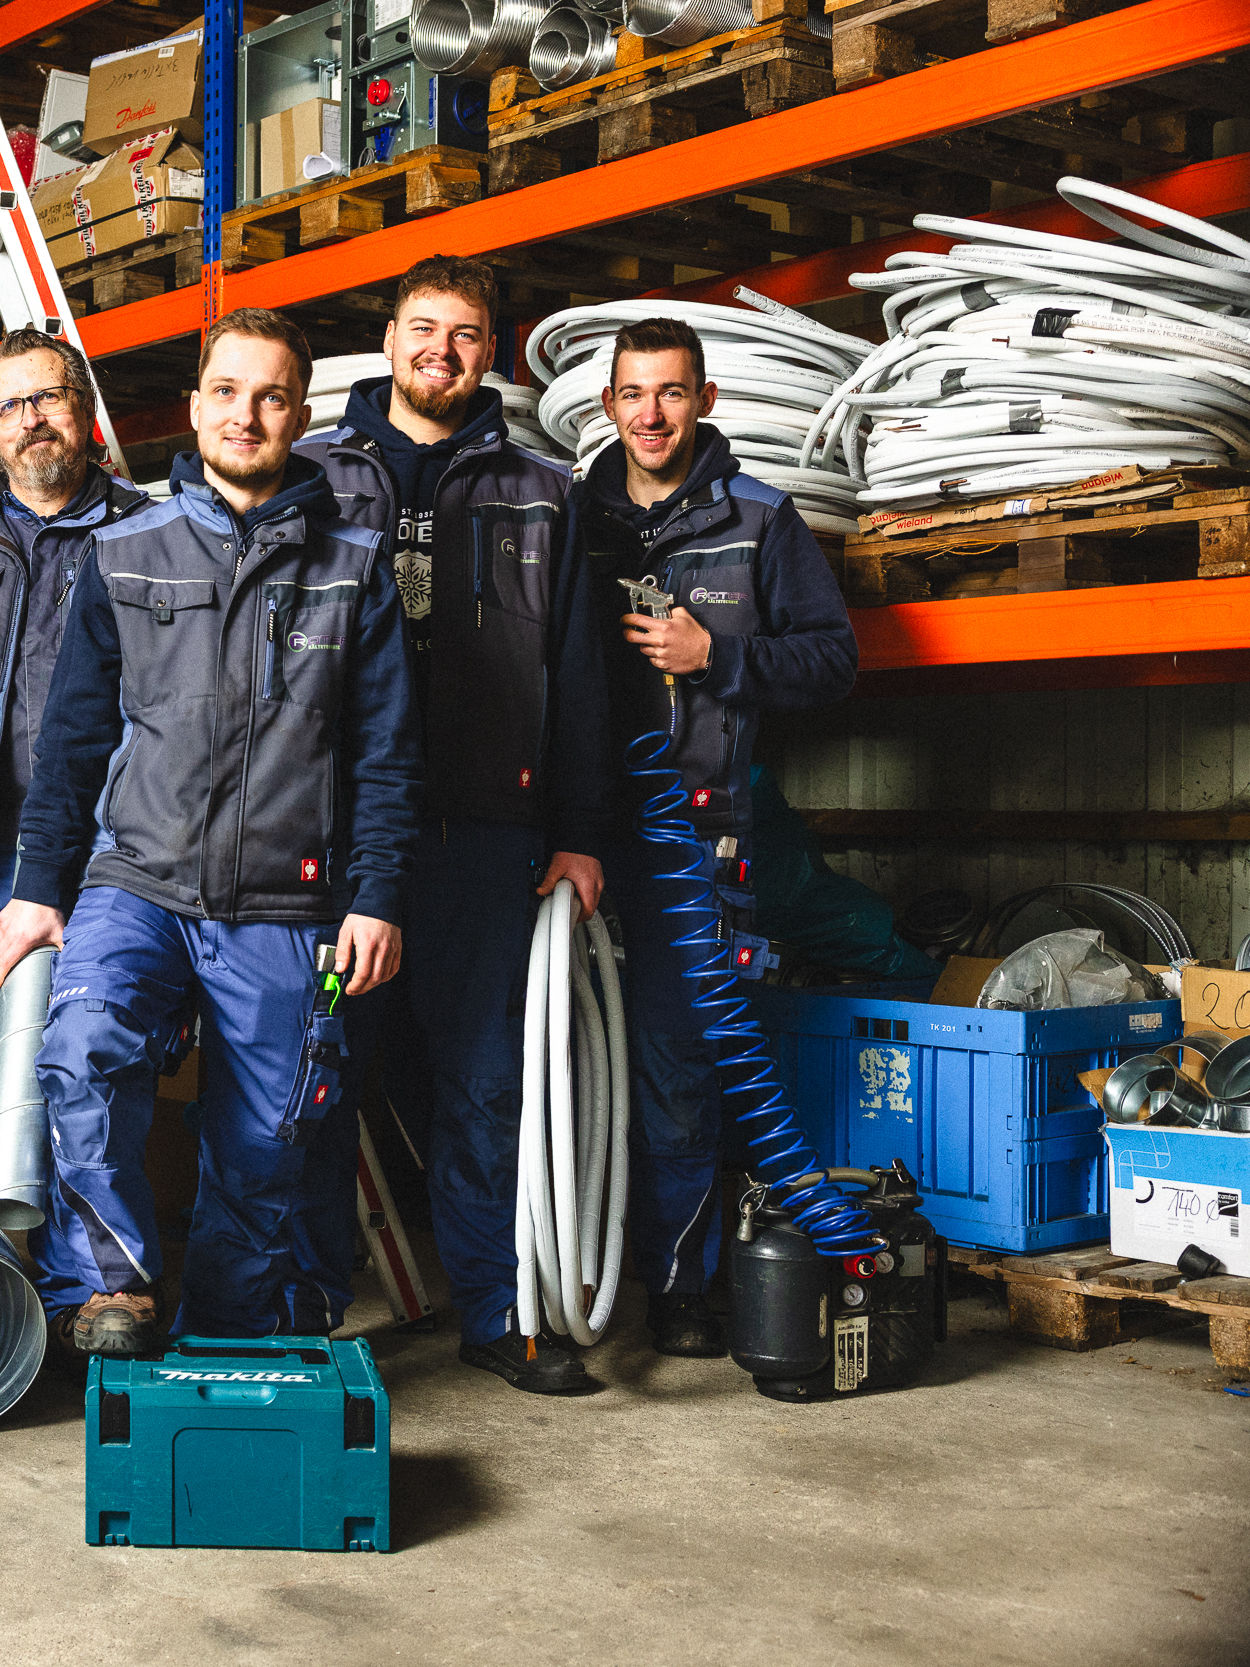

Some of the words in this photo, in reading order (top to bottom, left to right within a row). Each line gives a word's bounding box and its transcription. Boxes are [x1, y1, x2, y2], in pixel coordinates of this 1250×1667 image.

[116, 99, 157, 129] Danfoss
[136, 175, 146, 193] KEIL
[1081, 472, 1124, 490] wieland
[896, 515, 933, 530] wieland
[930, 1023, 940, 1031] TK
[942, 1025, 956, 1033] 201
